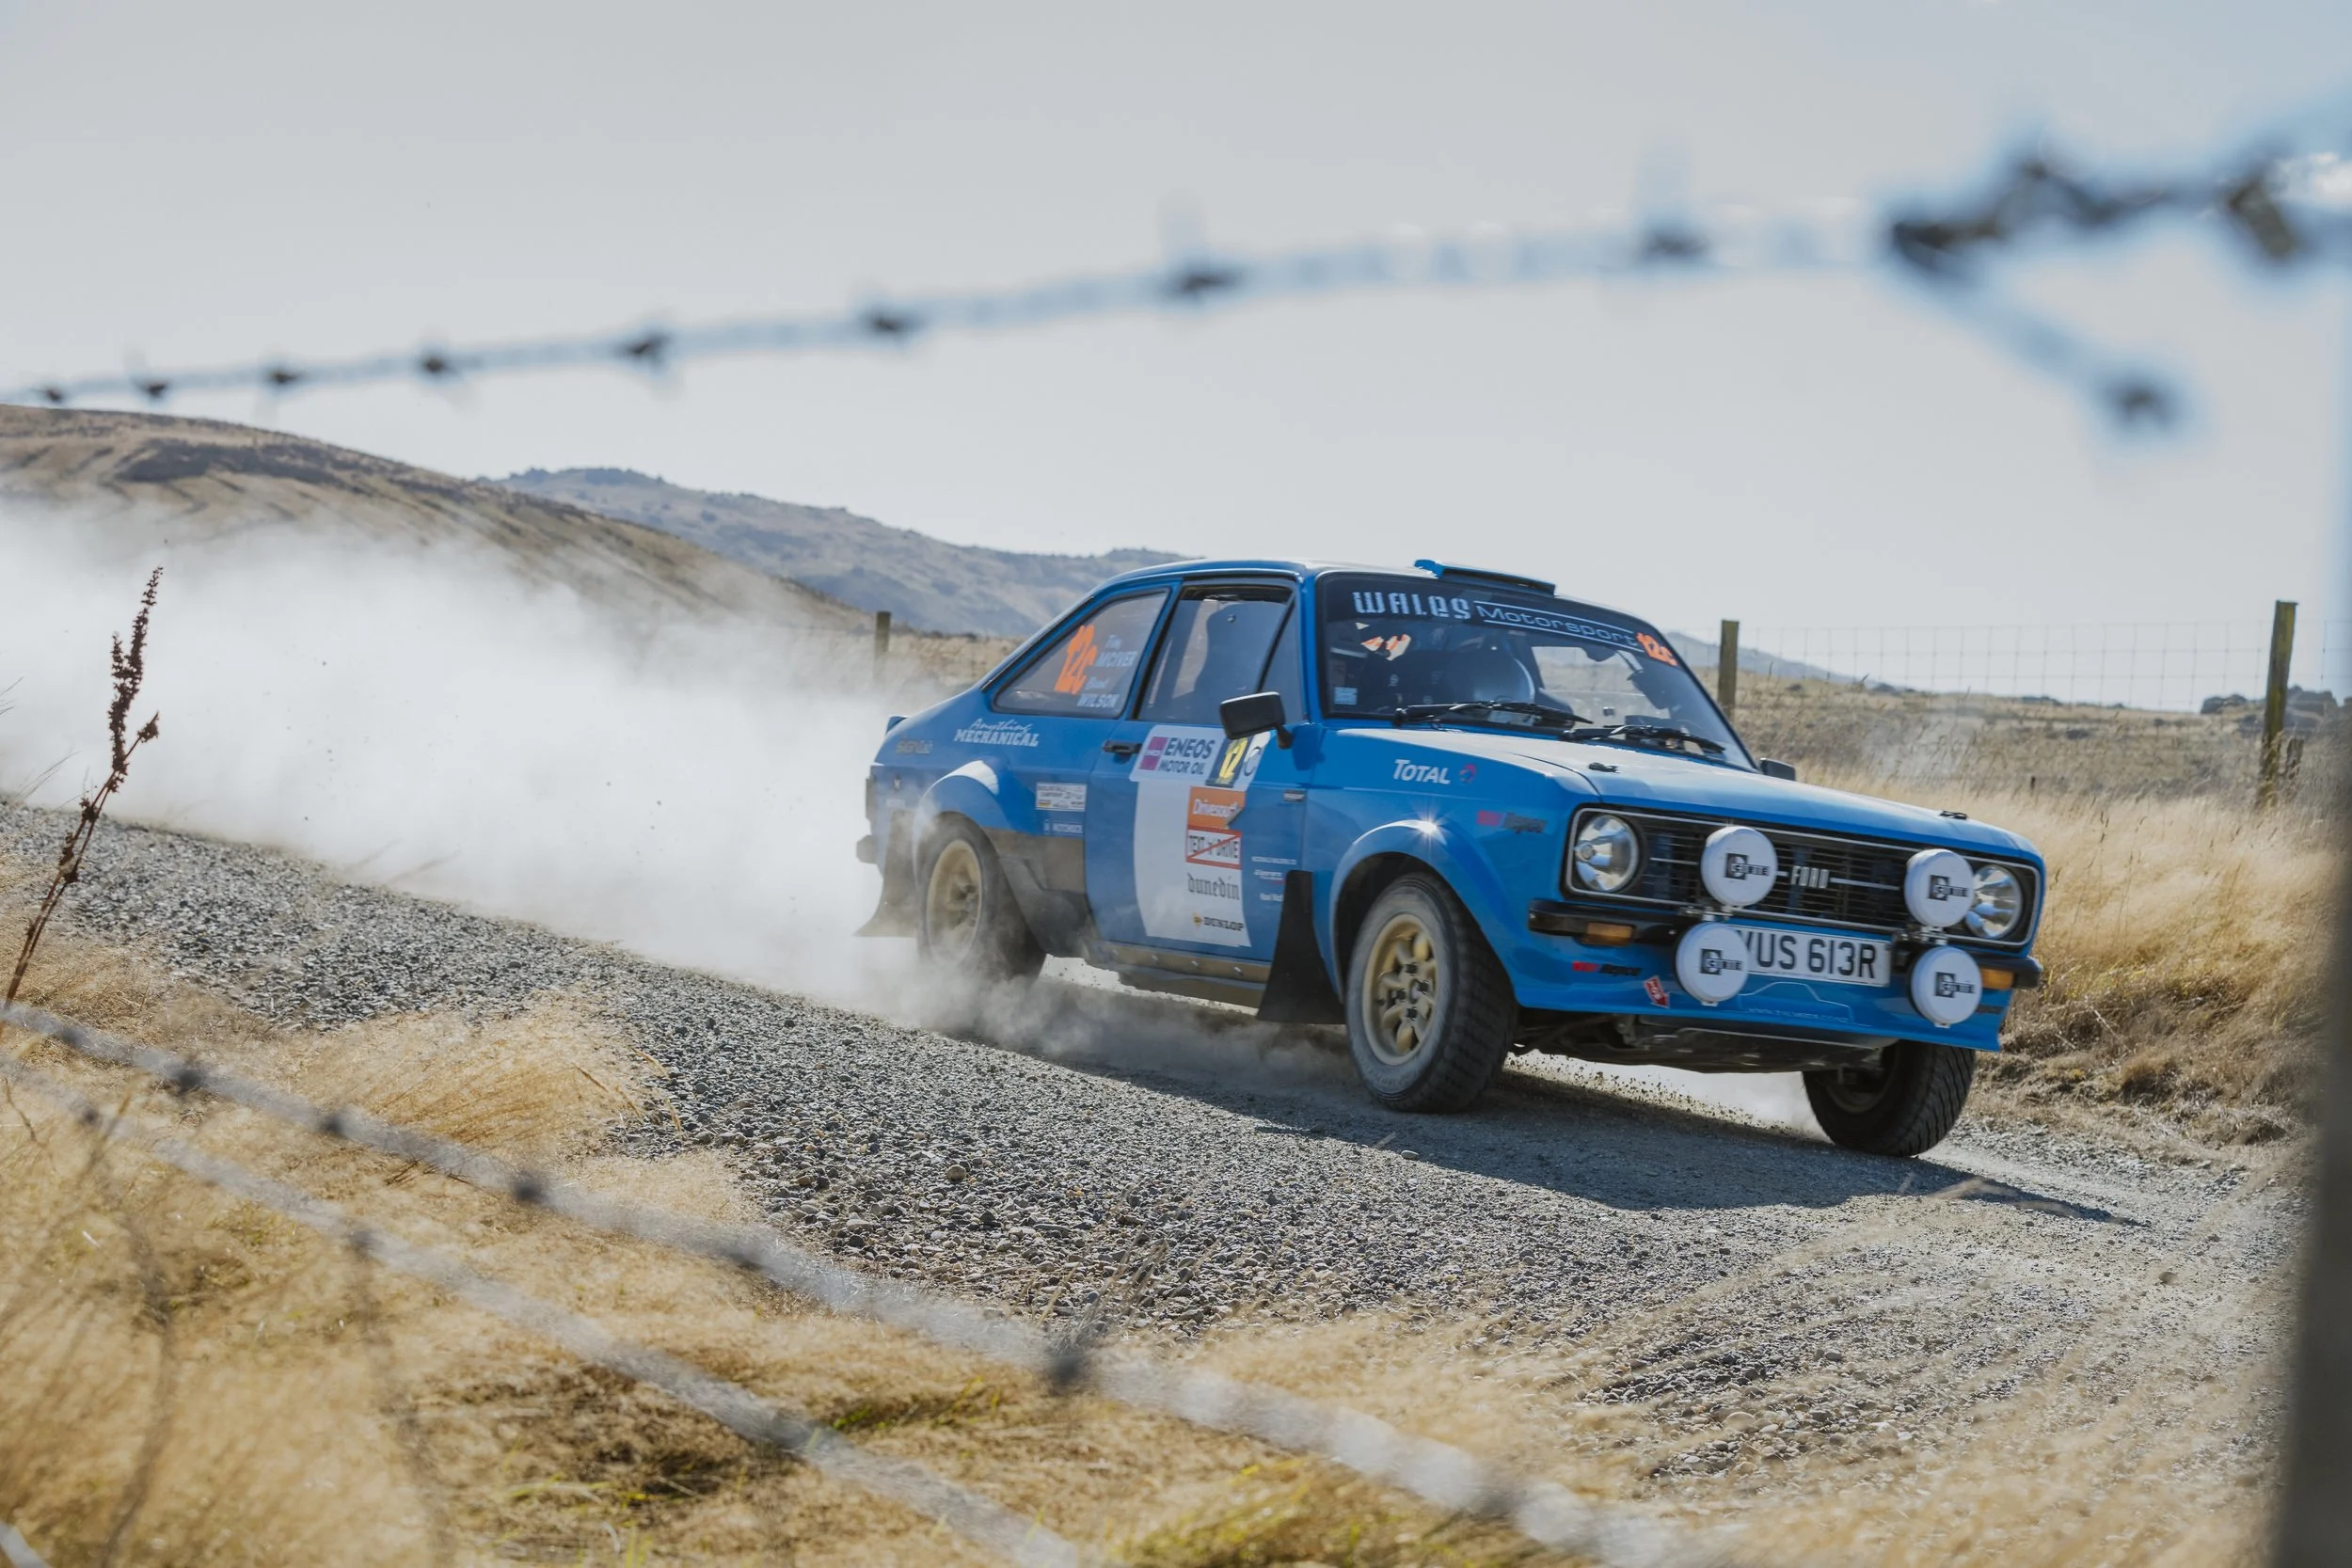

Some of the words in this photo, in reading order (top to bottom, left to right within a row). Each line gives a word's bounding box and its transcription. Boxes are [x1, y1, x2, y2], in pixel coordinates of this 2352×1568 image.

[1475, 605, 1639, 646] Motorsport
[969, 718, 1033, 734] Anything
[954, 729, 1040, 748] MECHANICAL
[1164, 736, 1216, 760] ENEOS
[1157, 759, 1190, 774] MOTOR
[1190, 761, 1206, 775] OIL
[1790, 864, 1830, 889] FORD
[1203, 916, 1244, 932] DUNLOP
[1807, 937, 1876, 979] 613R
